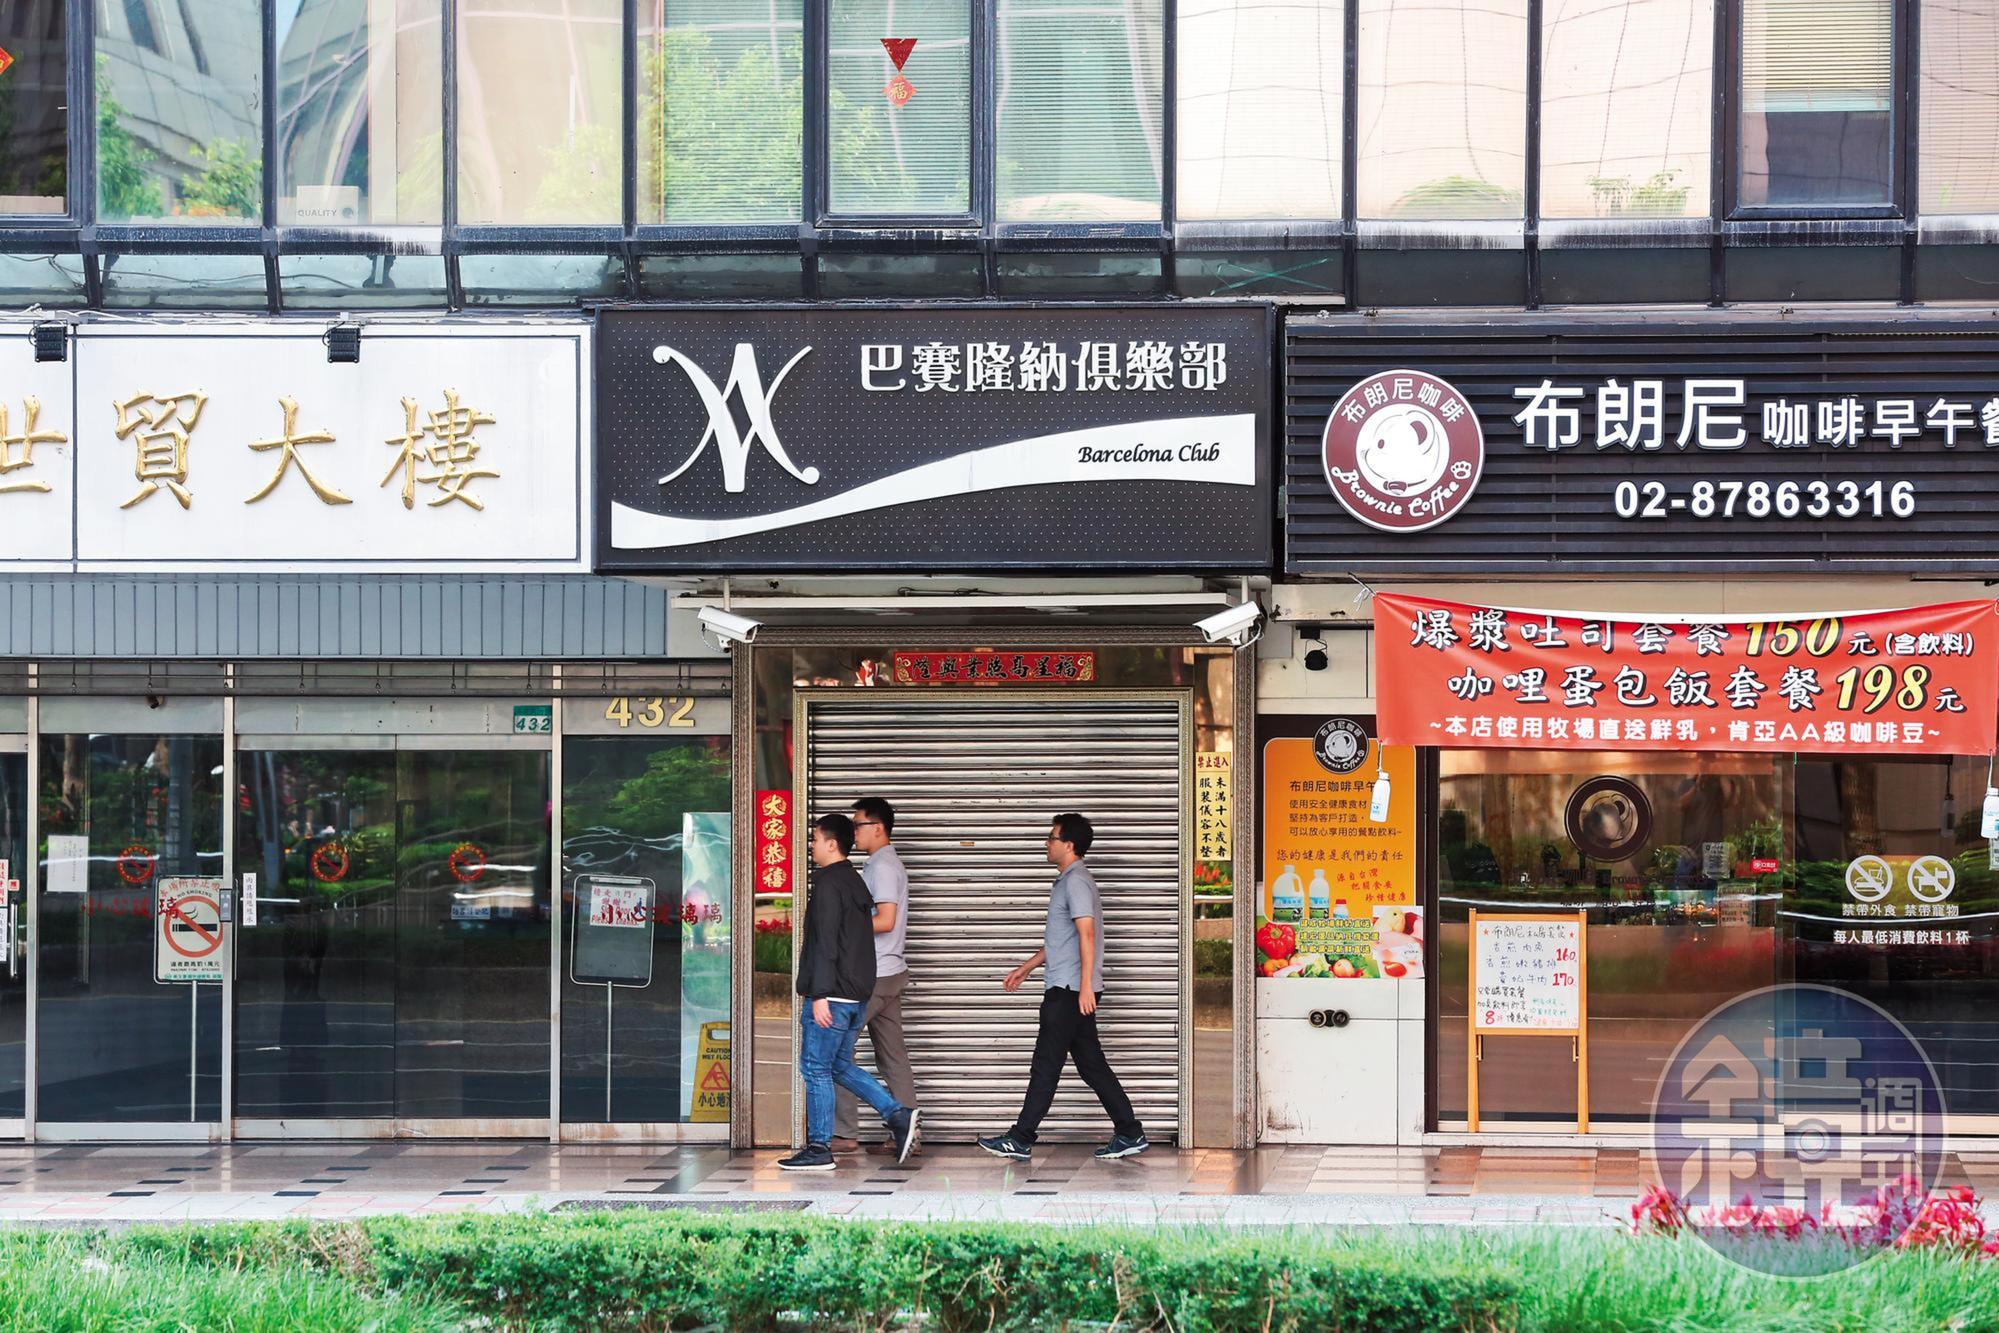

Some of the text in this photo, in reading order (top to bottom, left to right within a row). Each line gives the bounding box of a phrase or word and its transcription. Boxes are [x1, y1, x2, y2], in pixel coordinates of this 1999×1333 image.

[298, 209, 337, 217] QUALITY
[861, 340, 1228, 393] 巴賽隆納俱樂部
[1340, 377, 1465, 424] 布朗尼咖啡
[1078, 441, 1221, 464] Barcelona Club
[1331, 466, 1460, 517] Brownie Coffee
[1613, 480, 1917, 519] 02-87863316
[1744, 617, 1844, 657] 150
[1836, 663, 1932, 714] 198
[605, 697, 696, 728] 432
[515, 717, 551, 732] 432
[1319, 720, 1363, 738] 布朗尼咖啡
[1197, 756, 1229, 768] 禁止進入
[1289, 799, 1368, 809] 使用安全健康食材
[1215, 777, 1228, 858] 未滿十八歲者
[1276, 849, 1404, 862] 您的健康是我們的責任
[1842, 903, 1960, 917] 禁帶外食 禁帶寵物
[1833, 930, 1970, 945] 每人最低消費飲料1杯
